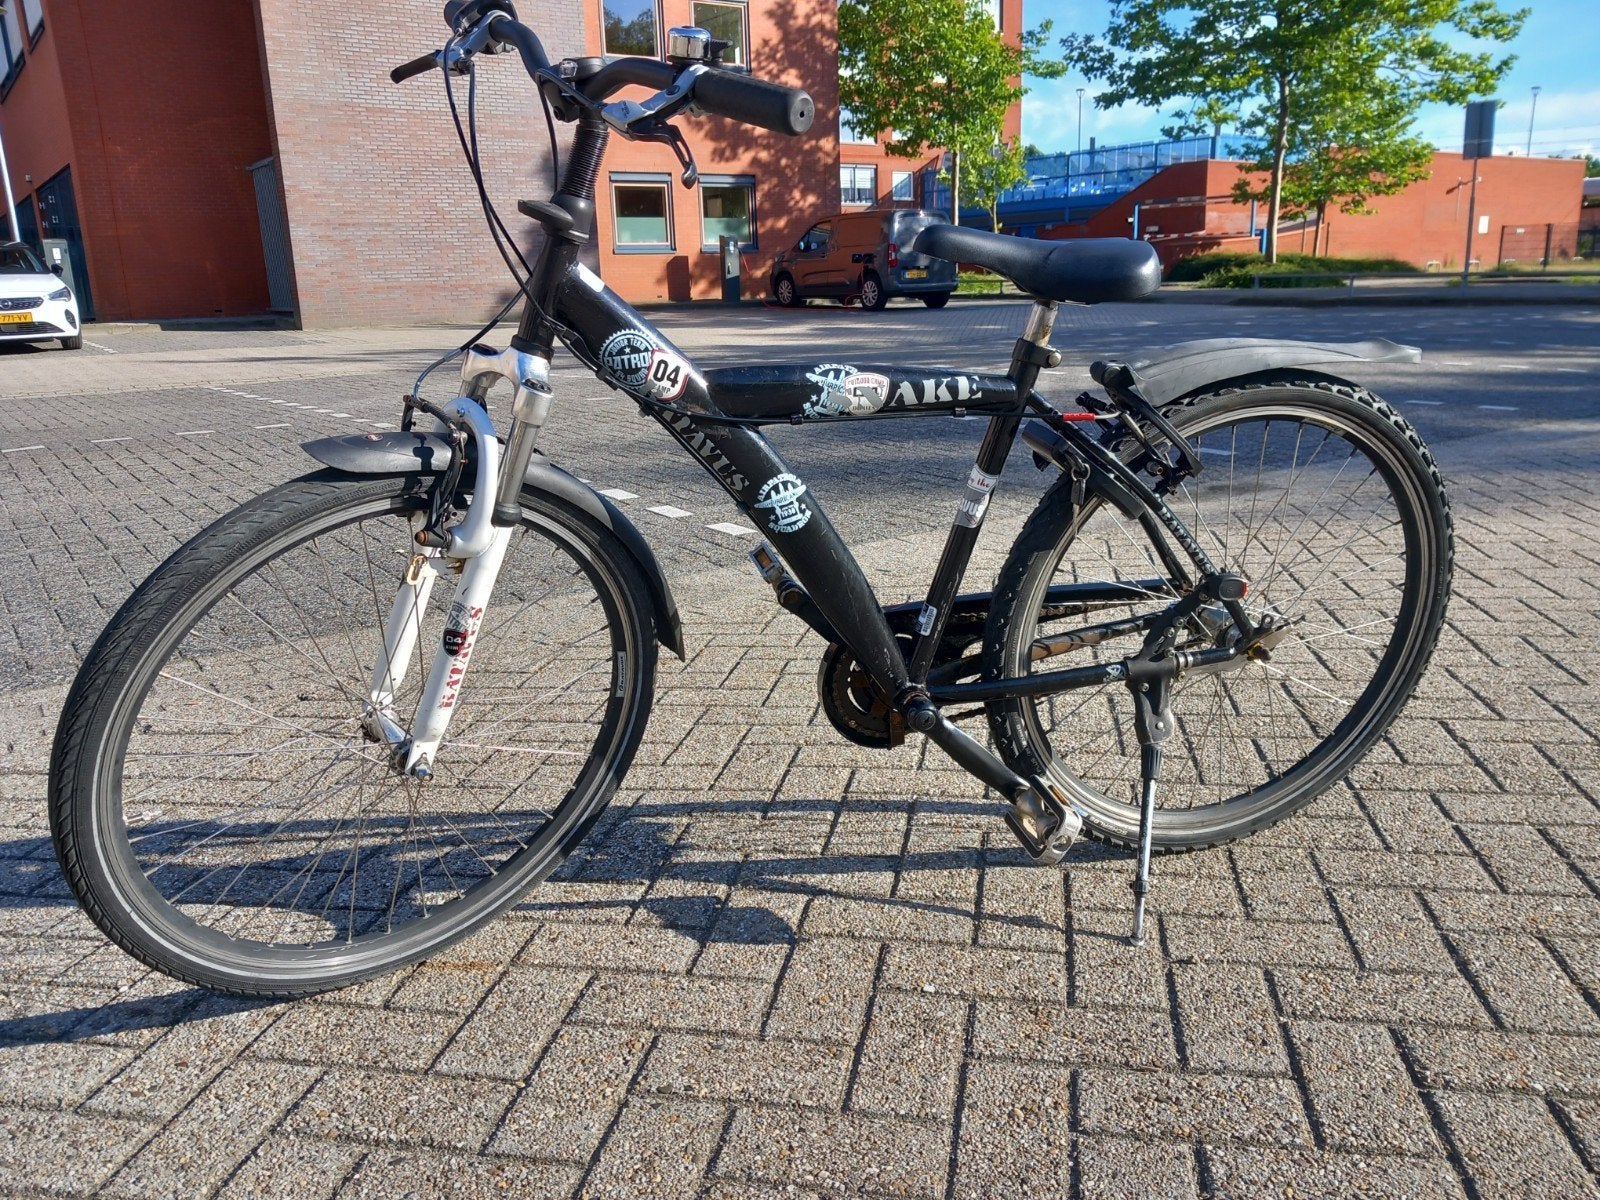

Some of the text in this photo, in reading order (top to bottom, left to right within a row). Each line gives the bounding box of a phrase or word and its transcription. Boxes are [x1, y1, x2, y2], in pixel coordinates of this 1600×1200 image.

[610, 338, 647, 355] JUNIOR TEAM
[653, 359, 681, 388] 04
[889, 376, 982, 407] AKE
[1158, 506, 1216, 575] BATAVUS
[446, 634, 462, 644] 04
